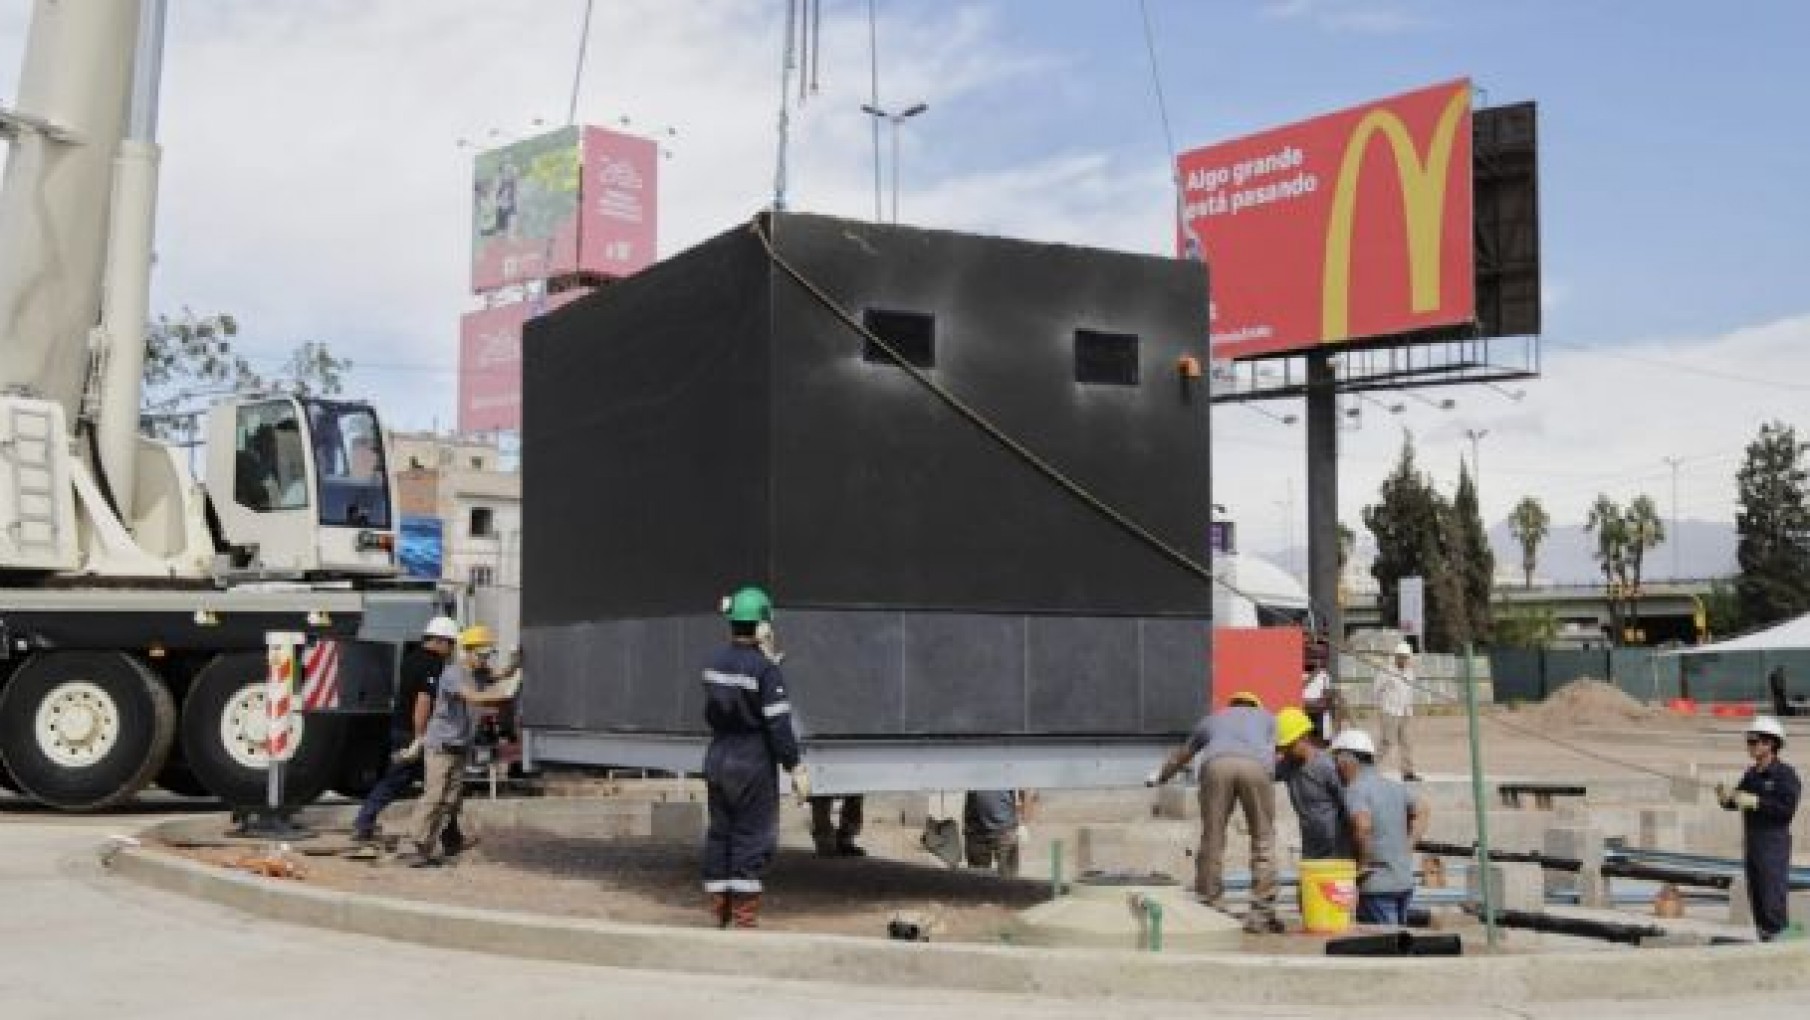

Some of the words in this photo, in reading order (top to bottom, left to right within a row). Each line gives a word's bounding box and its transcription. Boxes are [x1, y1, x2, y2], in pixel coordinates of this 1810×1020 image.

[1187, 167, 1229, 191] Algo
[1233, 147, 1303, 186] grande
[1231, 173, 1318, 215] pasando
